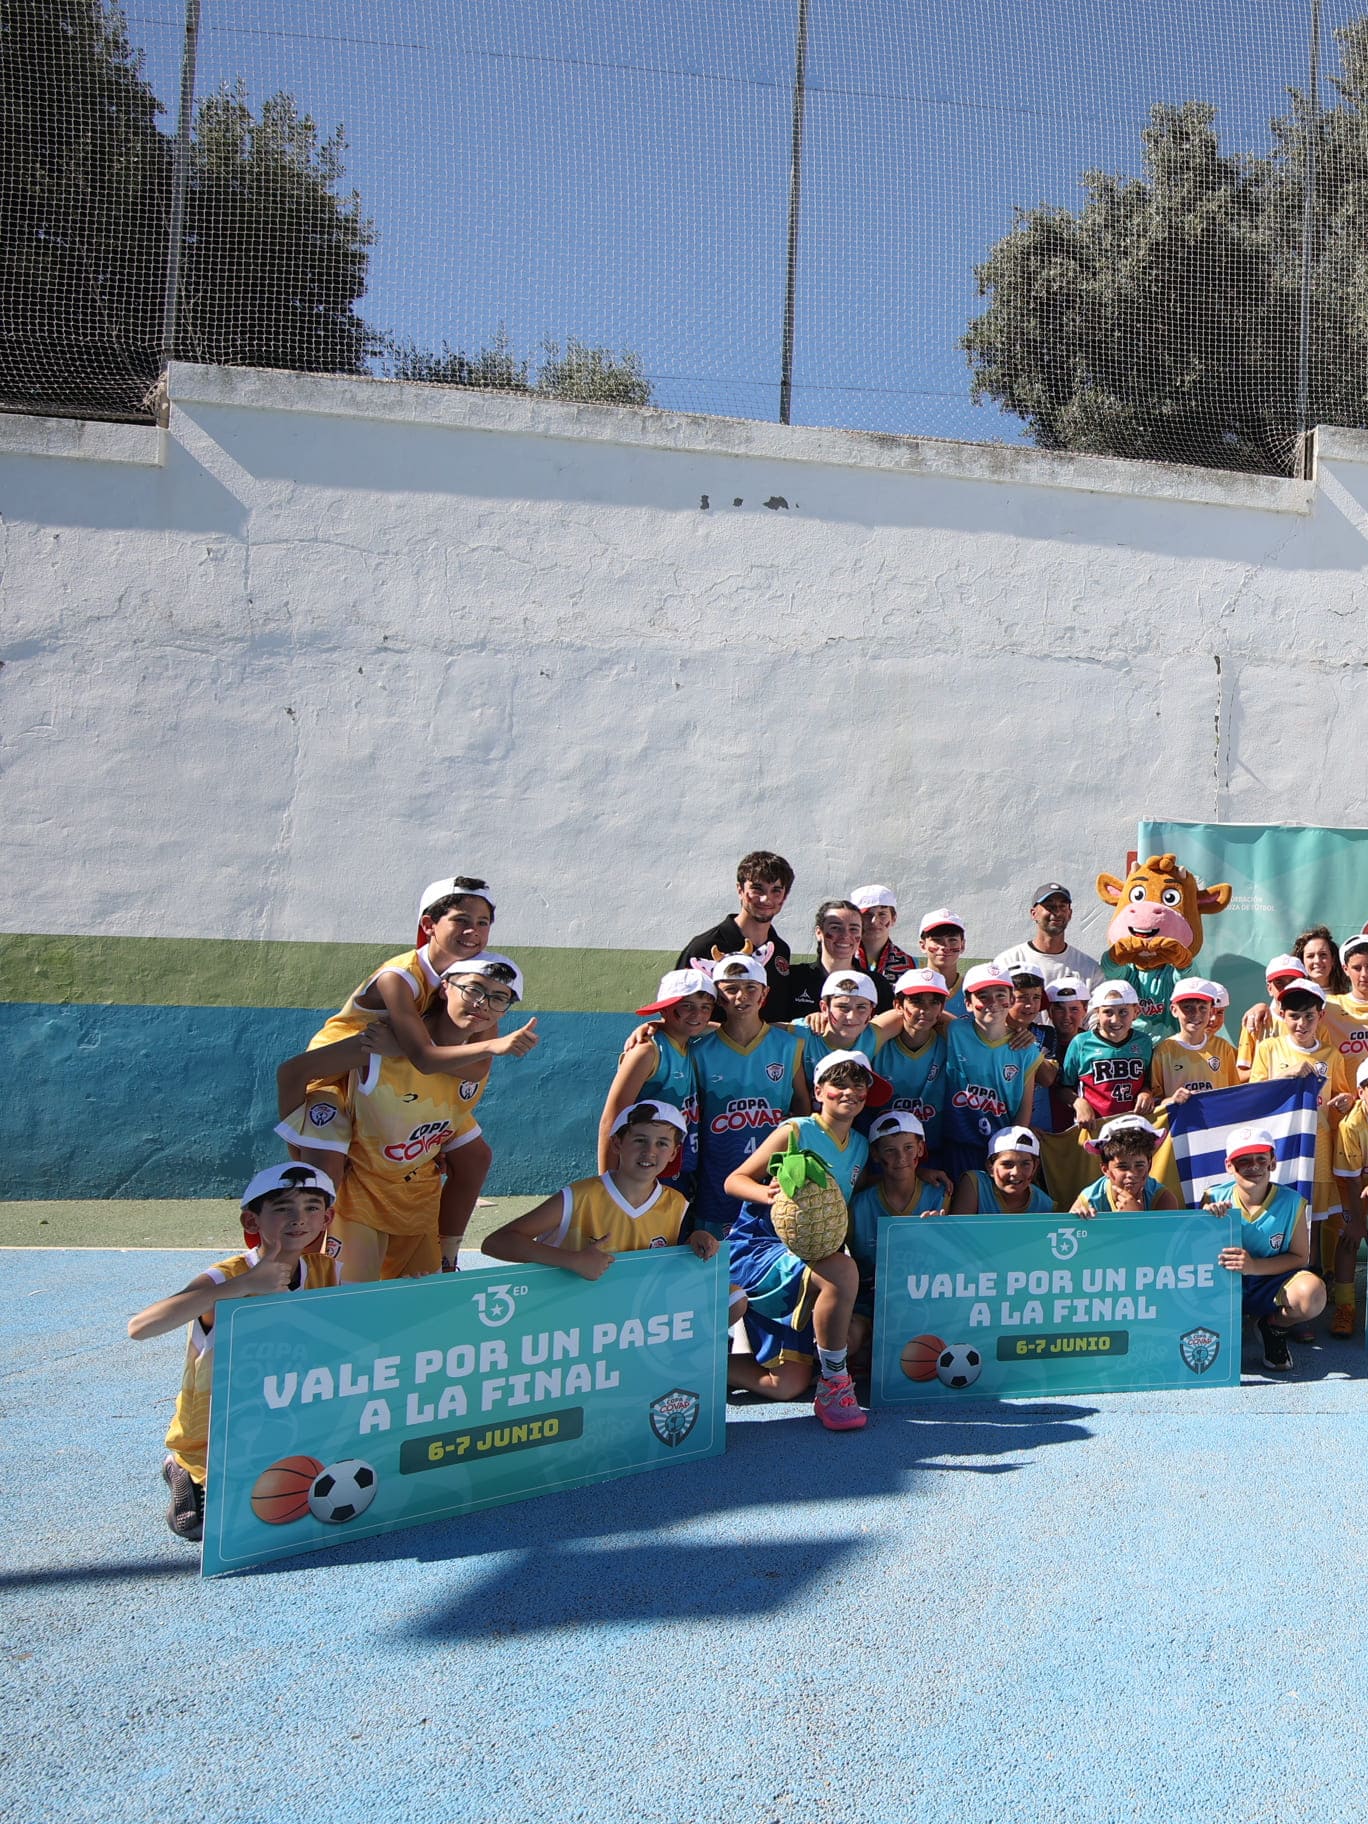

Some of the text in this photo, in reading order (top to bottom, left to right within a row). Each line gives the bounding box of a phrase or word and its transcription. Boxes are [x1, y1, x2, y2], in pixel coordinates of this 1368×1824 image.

[1093, 1059, 1144, 1085] RBC
[1111, 1083, 1133, 1102] 42
[1185, 1082, 1213, 1091] COPA
[728, 1098, 769, 1112] COPA
[978, 1117, 992, 1135] 9
[743, 1136, 757, 1153] 4
[1046, 1227, 1088, 1260] 13 ED
[907, 1263, 1215, 1299] VALE POR UN PASE
[471, 1284, 529, 1327] 13 ED
[969, 1295, 1157, 1327] A LA FINAL
[1016, 1336, 1111, 1355] 6-7 JUNIO
[263, 1310, 695, 1410] VALE POR UN PASE
[359, 1360, 620, 1435] A LA FINAL
[660, 1401, 690, 1413] COVAP
[667, 1397, 684, 1405] COPA
[428, 1418, 560, 1461] 6-7 JUNIO
